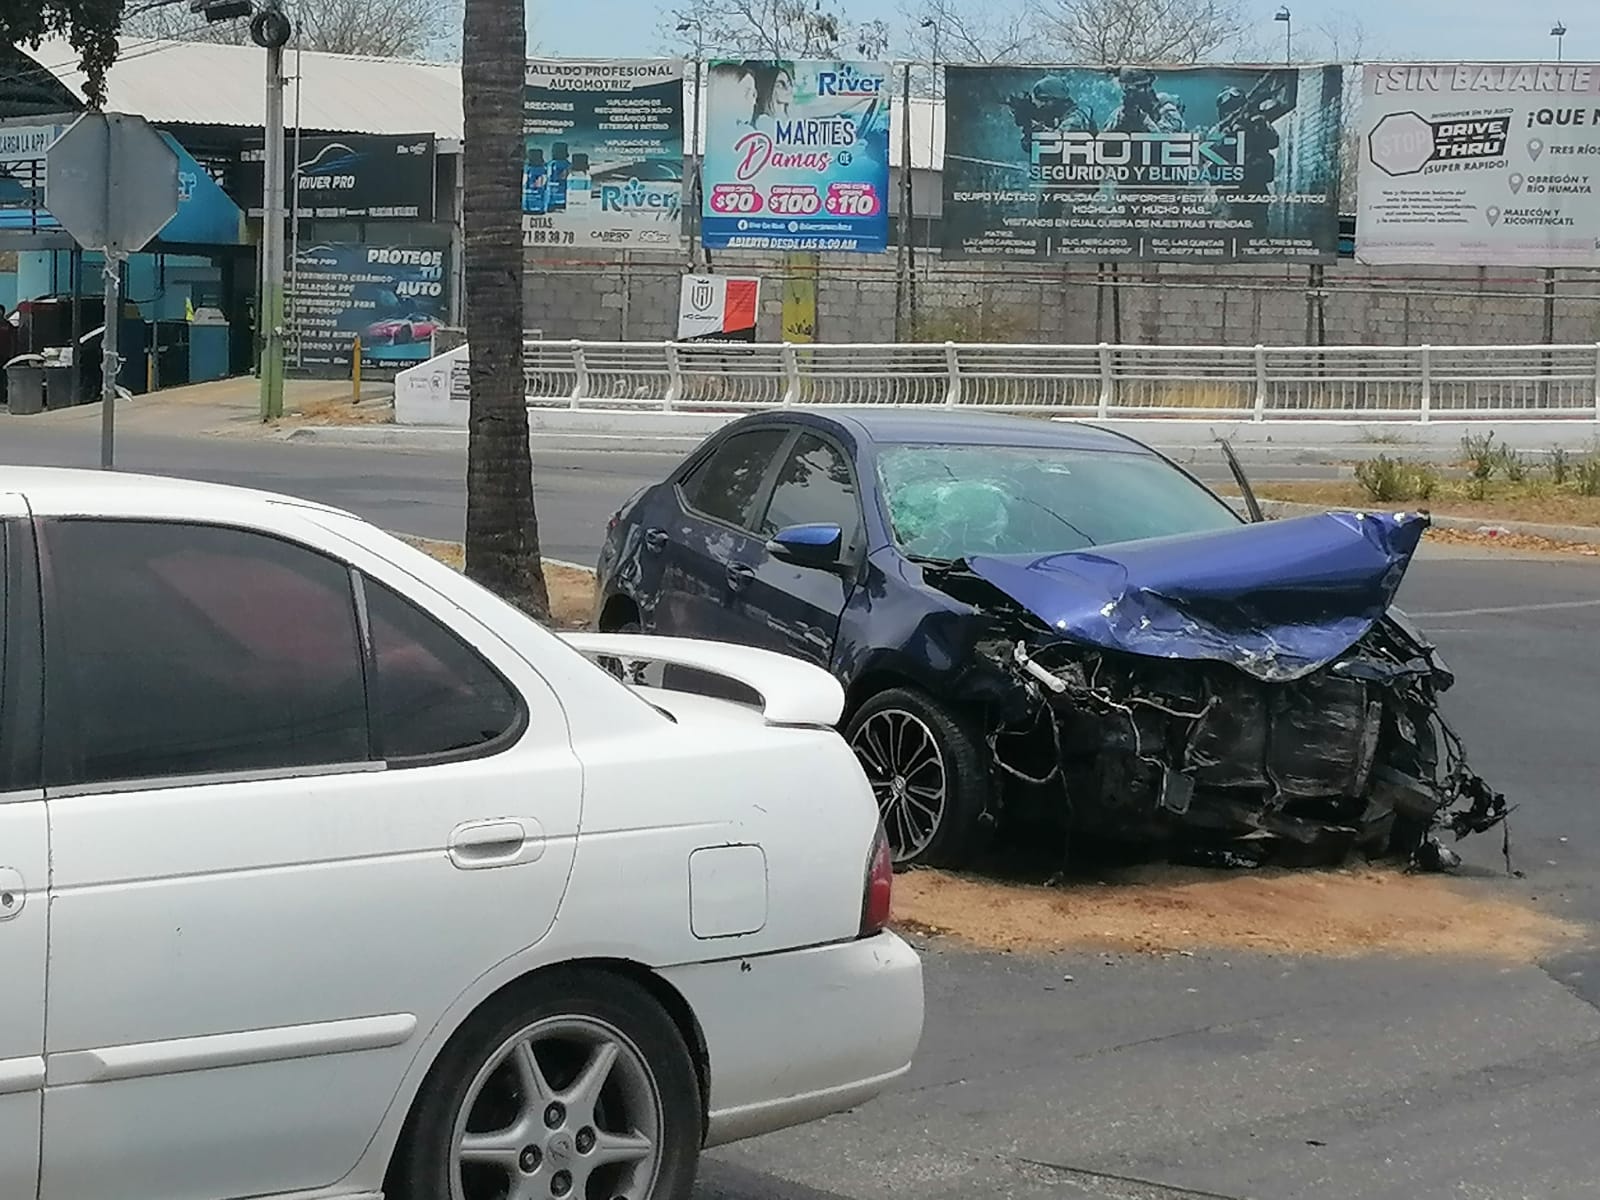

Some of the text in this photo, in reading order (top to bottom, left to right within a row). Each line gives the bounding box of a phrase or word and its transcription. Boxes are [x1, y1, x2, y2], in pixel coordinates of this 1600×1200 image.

[584, 65, 673, 77] PROFESIONAL
[549, 78, 632, 90] AUTOMOTRIZ
[818, 70, 885, 96] River
[1375, 65, 1592, 95] ¡SIN BAJARTE
[1527, 108, 1585, 129] ¡QUE
[775, 119, 856, 146] MARTES
[1438, 120, 1504, 138] DRIVE
[735, 132, 831, 180] Damas
[1436, 142, 1501, 158] THRU
[1549, 146, 1574, 155] TRES
[1029, 165, 1245, 182] SEGURIDAD Y BLINDAJES
[1527, 174, 1589, 184] OBREGÓN Y
[300, 175, 355, 189] RIVER PRO
[1547, 185, 1592, 194] HUMAYA
[601, 184, 674, 212] River
[715, 193, 754, 212] $90
[769, 194, 818, 214] $100
[953, 192, 991, 201] EQUIPO
[1042, 193, 1050, 201] Y
[1226, 194, 1278, 204] CALZADO
[1142, 206, 1180, 215] MUCHO
[1503, 207, 1560, 217] MALECÓN Y
[1151, 219, 1206, 229] NUESTRAS
[727, 236, 769, 249] ABIERTO
[770, 237, 799, 250] DESDE
[800, 238, 818, 250] LAS
[840, 239, 857, 250] AM
[367, 249, 443, 265] PROTEGE
[396, 281, 442, 296] AUTO
